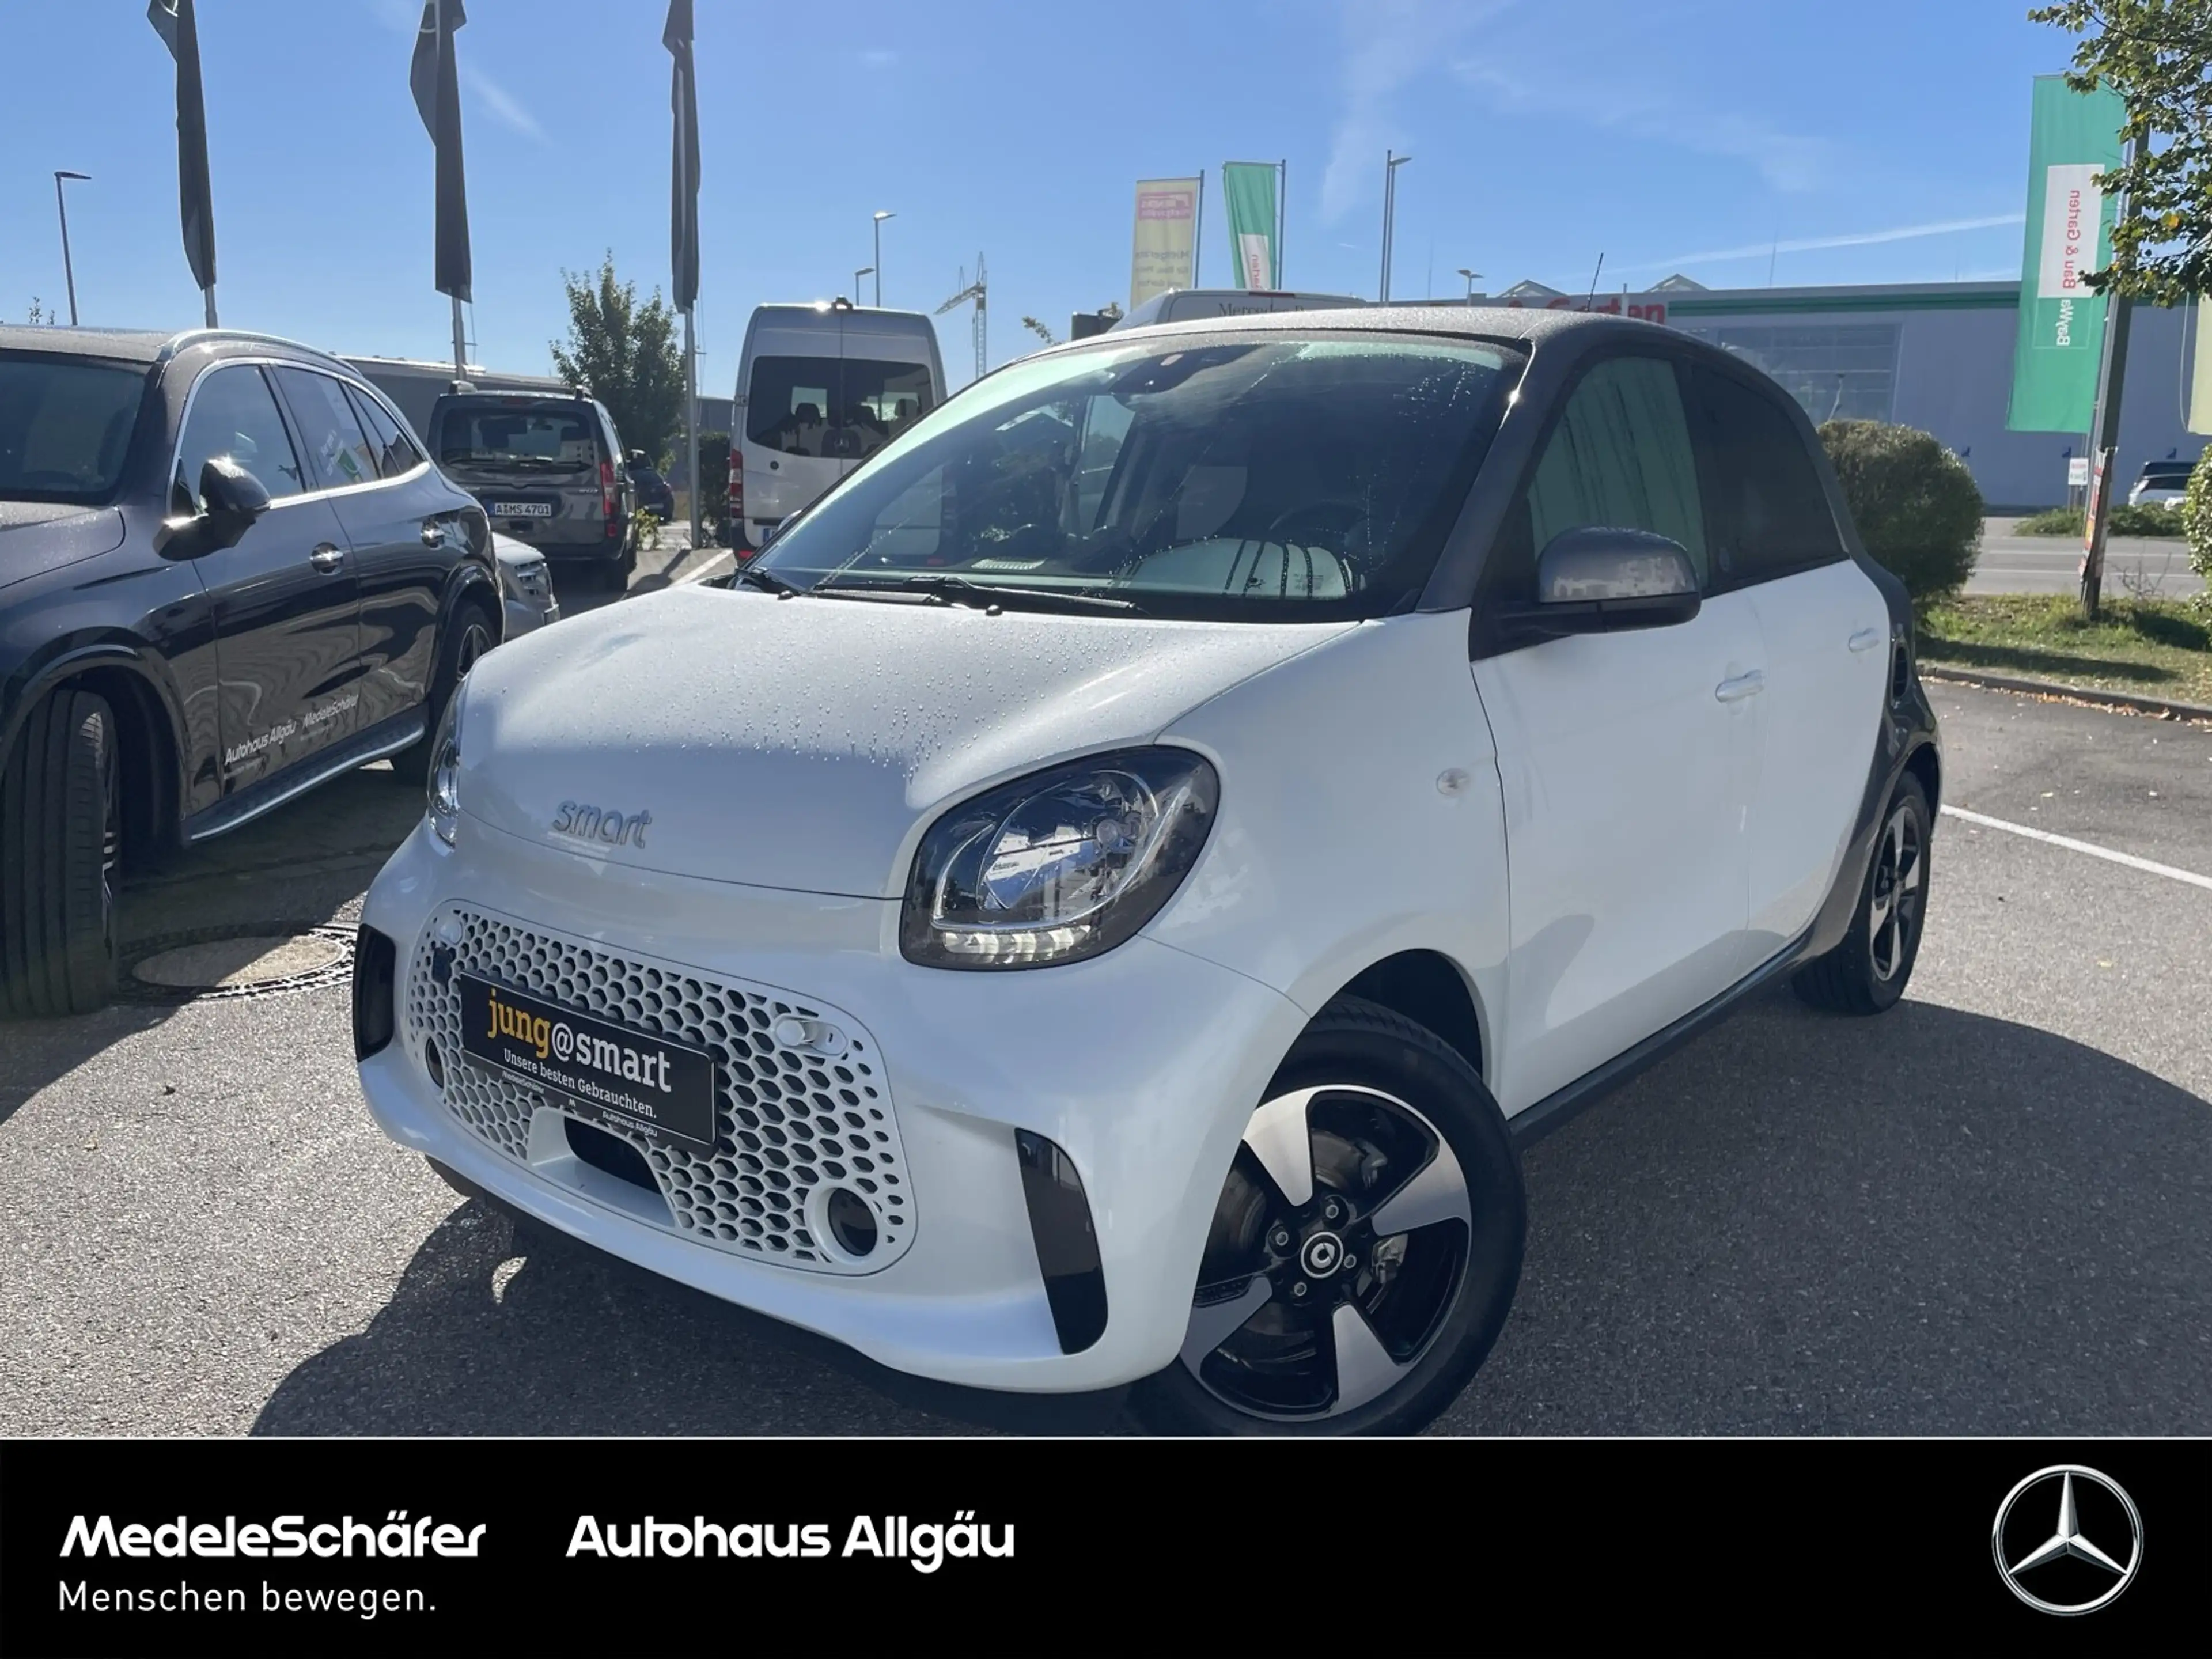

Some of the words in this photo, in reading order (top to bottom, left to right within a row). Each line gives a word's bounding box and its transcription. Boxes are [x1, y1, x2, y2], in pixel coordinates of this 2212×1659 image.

[224, 733, 269, 766] Autohaus
[269, 719, 297, 744] Allgäu
[552, 800, 652, 849] smart
[488, 988, 672, 1093] jung@smart
[504, 1048, 538, 1074] Unsere
[540, 1062, 575, 1089] besten
[578, 1078, 657, 1119] Gebrauchten.
